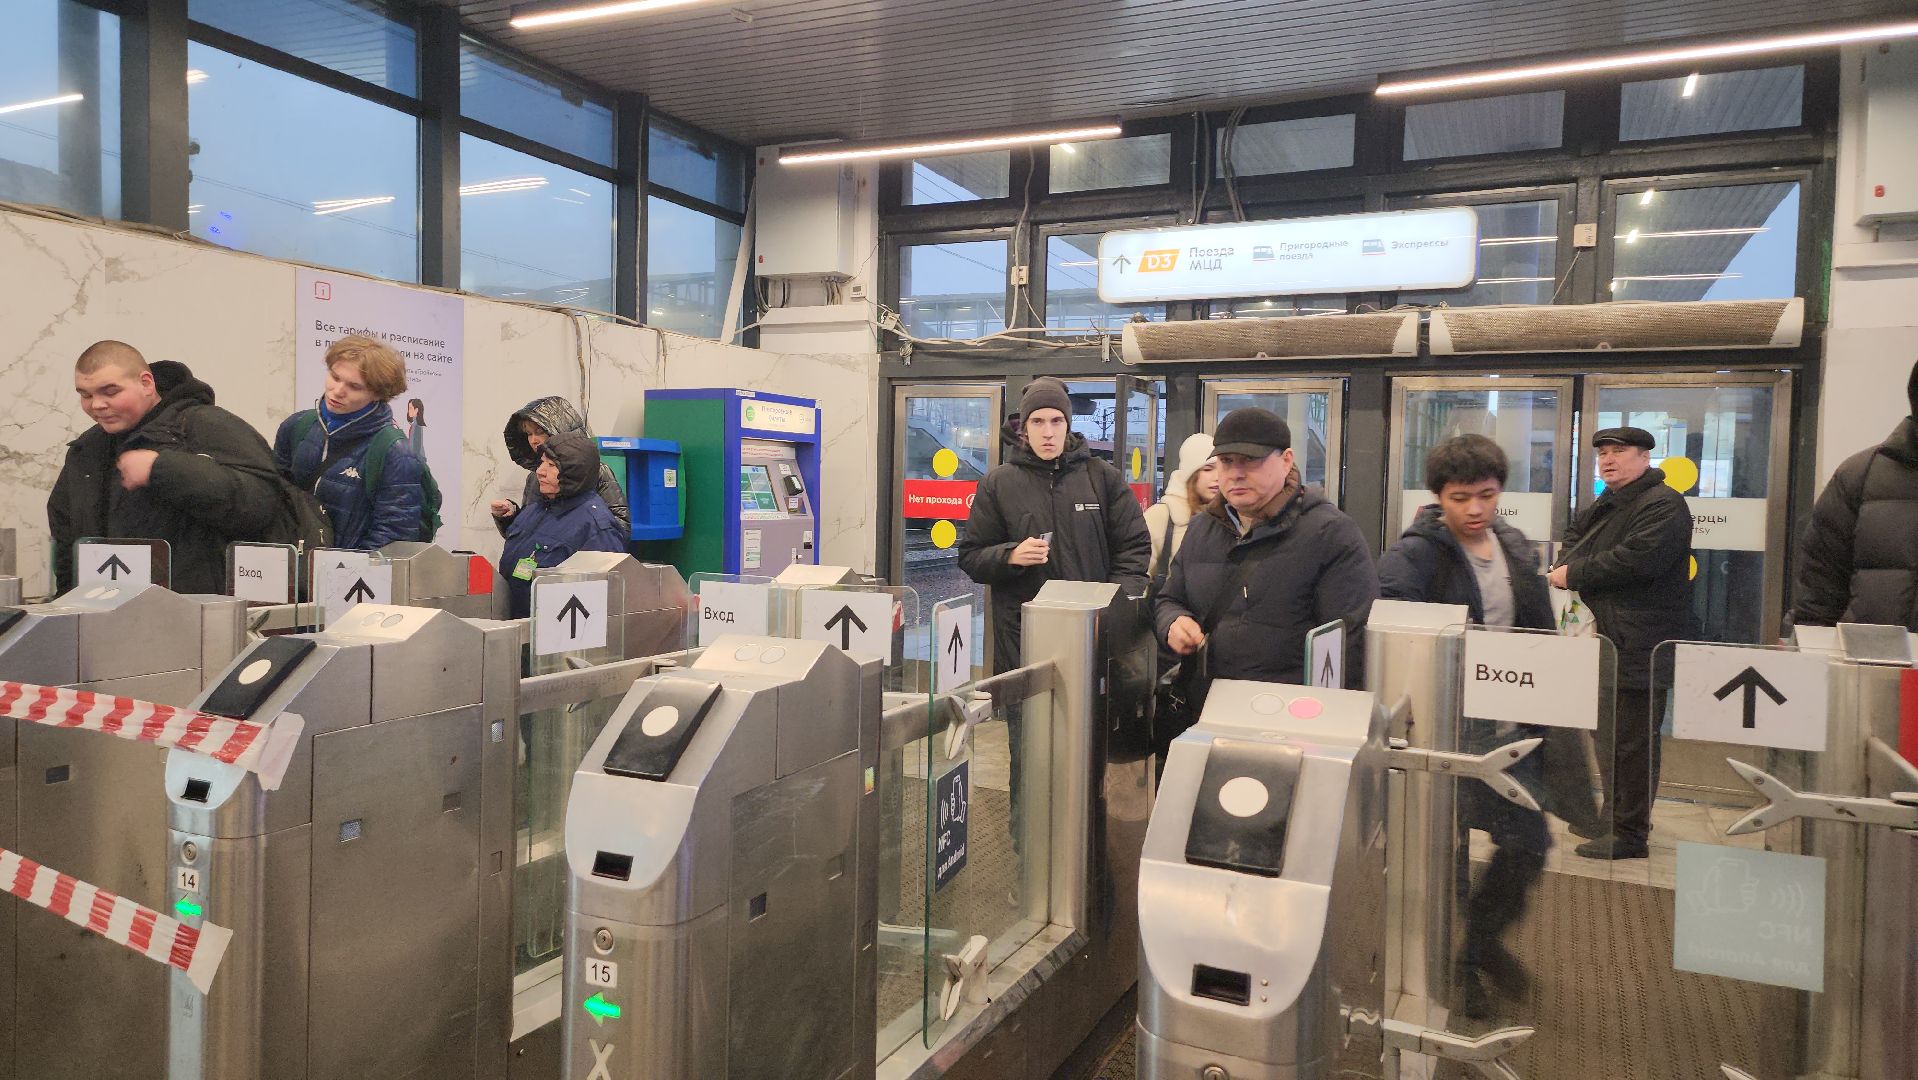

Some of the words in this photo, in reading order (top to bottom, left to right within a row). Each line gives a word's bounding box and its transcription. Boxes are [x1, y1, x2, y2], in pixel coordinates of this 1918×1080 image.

[1189, 246, 1234, 258] Поезда
[1279, 239, 1349, 252] Пригородные
[1391, 239, 1449, 250] Экспрессы
[1147, 254, 1172, 270] D3
[1189, 259, 1223, 271] МЦД
[315, 320, 336, 332] Все
[338, 326, 379, 338] тарифы
[381, 332, 387, 340] и
[389, 333, 446, 349] расписание
[315, 339, 321, 347] в
[413, 351, 425, 361] на
[427, 353, 453, 364] сайте
[908, 494, 925, 503] Нет
[925, 496, 963, 505] прохода
[239, 566, 262, 580] Вход
[704, 606, 735, 623] Вход
[1475, 664, 1534, 688] Вход
[938, 830, 950, 854] NFC
[947, 843, 965, 868] Android
[181, 872, 196, 889] 14
[591, 963, 611, 983] 15
